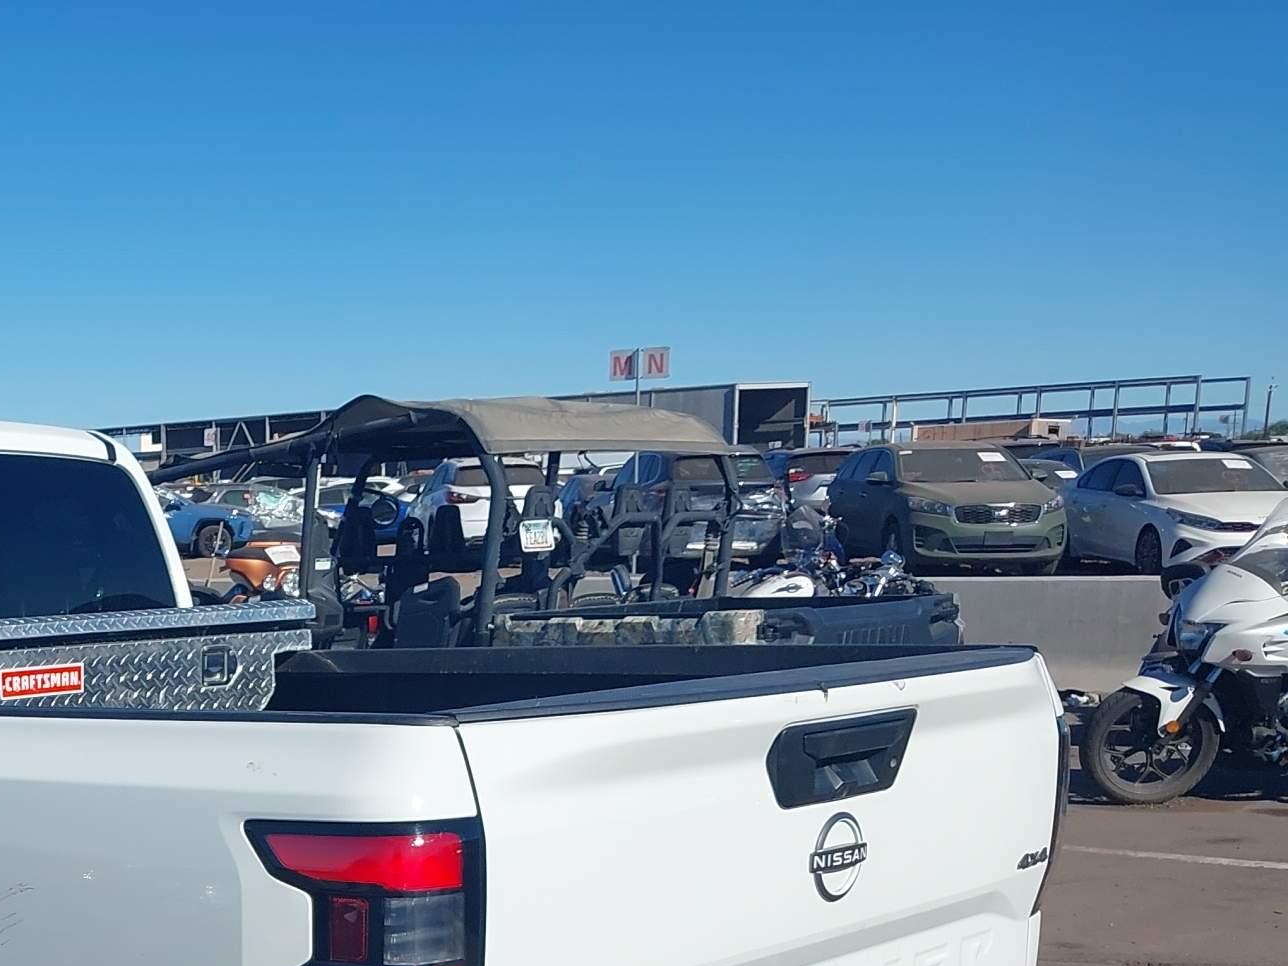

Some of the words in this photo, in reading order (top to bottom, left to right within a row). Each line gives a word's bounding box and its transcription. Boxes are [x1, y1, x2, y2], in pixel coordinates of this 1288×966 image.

[613, 355, 633, 376] M
[648, 352, 664, 374] N
[5, 671, 79, 692] CRAFTSMAN
[813, 846, 867, 869] NISSAN
